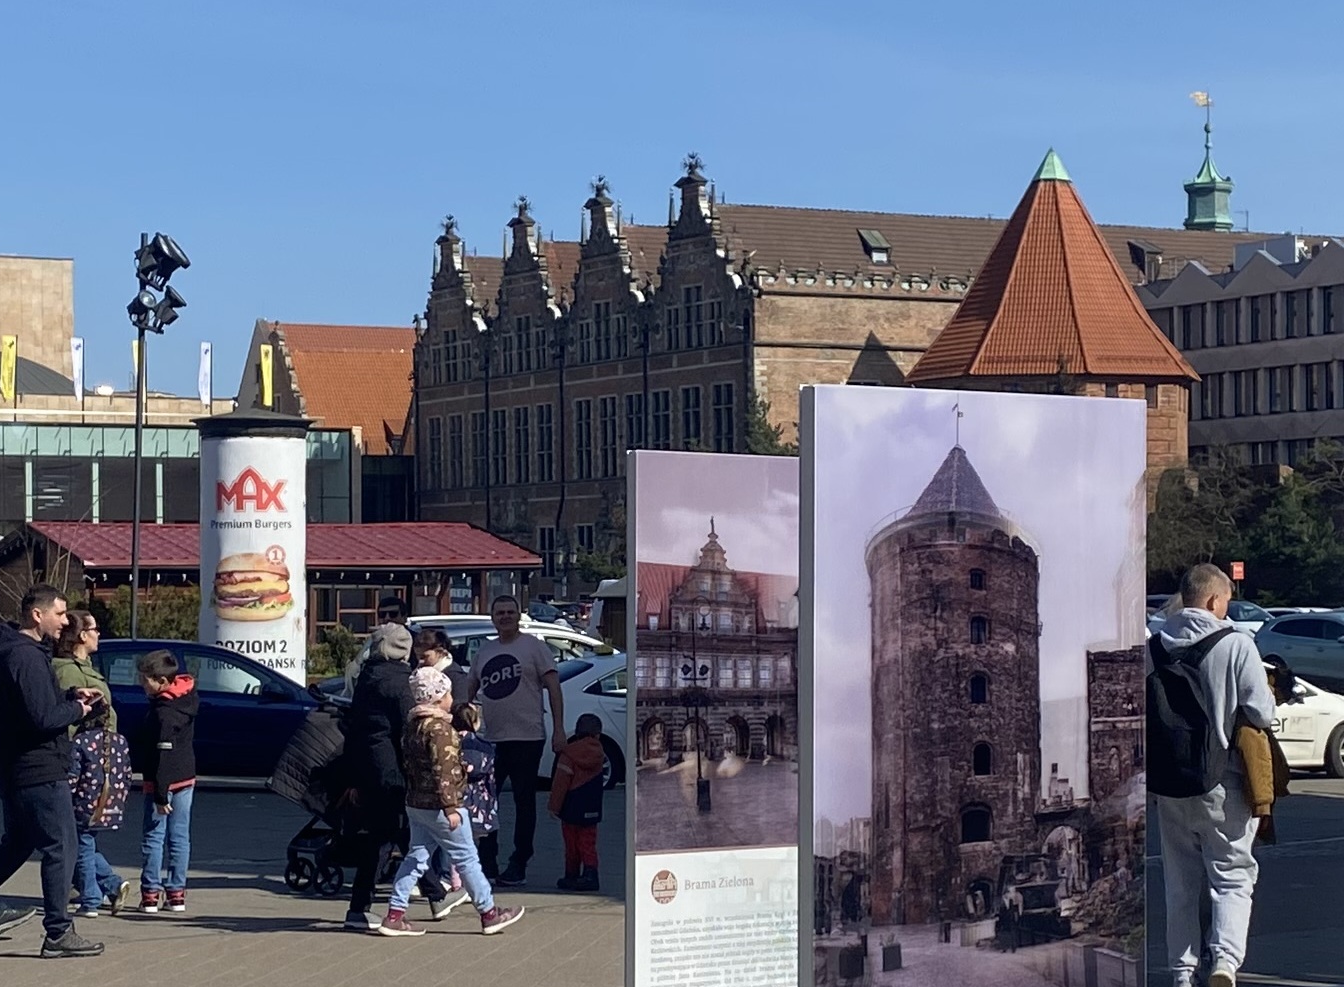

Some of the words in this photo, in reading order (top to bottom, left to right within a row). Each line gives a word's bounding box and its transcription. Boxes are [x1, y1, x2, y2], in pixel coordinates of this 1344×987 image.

[216, 466, 288, 513] MAX
[211, 519, 252, 530] Premium
[254, 519, 293, 532] Burgers
[280, 640, 287, 653] 2
[480, 663, 523, 688] CORE
[684, 879, 716, 891] Brama
[718, 876, 754, 889] Zielona
